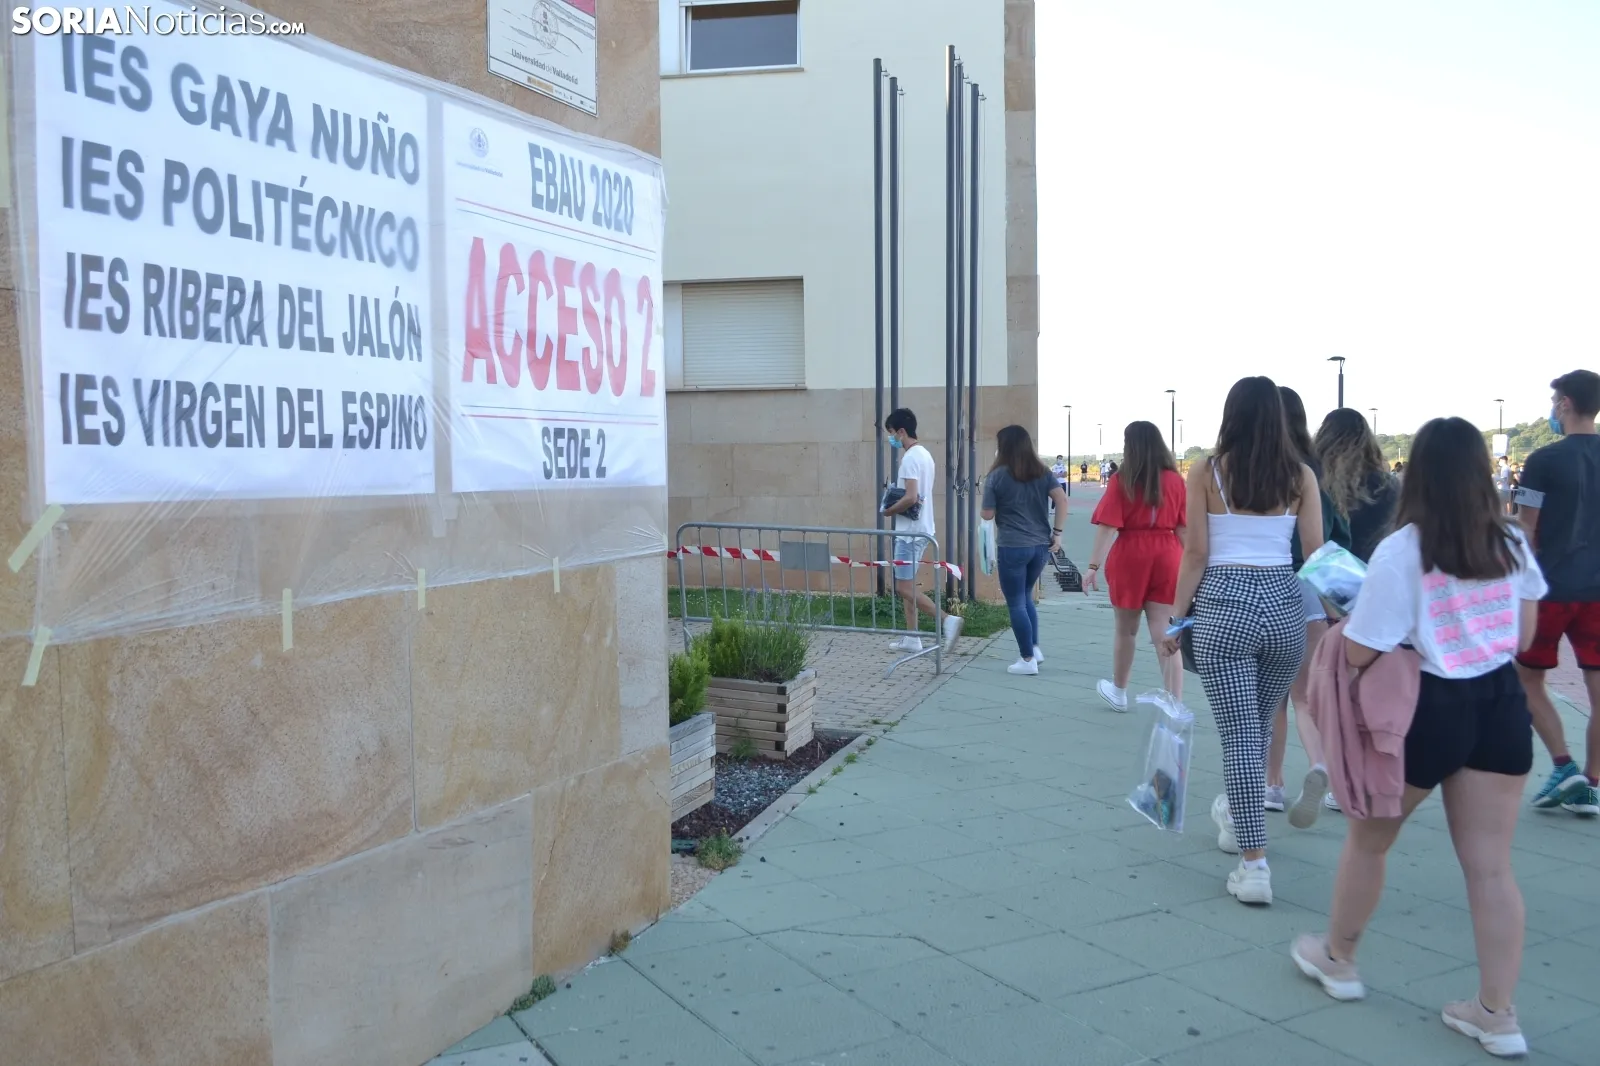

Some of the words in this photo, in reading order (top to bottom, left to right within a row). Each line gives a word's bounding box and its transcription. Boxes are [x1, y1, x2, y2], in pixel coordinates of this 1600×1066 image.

[61, 32, 153, 112] IES
[170, 62, 297, 153] GAYA
[311, 103, 420, 185] NUÑO
[511, 48, 546, 71] Universidad
[552, 66, 579, 85] Valladolid
[61, 136, 145, 221] IES
[162, 158, 420, 272] POLITÉCNICO
[528, 142, 586, 222] EBAU
[590, 164, 635, 236] 2020
[64, 252, 130, 334] IES
[143, 263, 268, 347] RIBERA
[277, 283, 335, 354] DEL
[341, 285, 423, 362] JALÓN
[461, 236, 628, 397] ACCESO
[636, 275, 656, 398] 2
[60, 373, 126, 447] IES
[132, 378, 266, 449] VIRGEN
[276, 386, 334, 449] DEL
[341, 390, 428, 451] ESPINO
[541, 426, 591, 480] SEDE
[595, 428, 607, 479] 2
